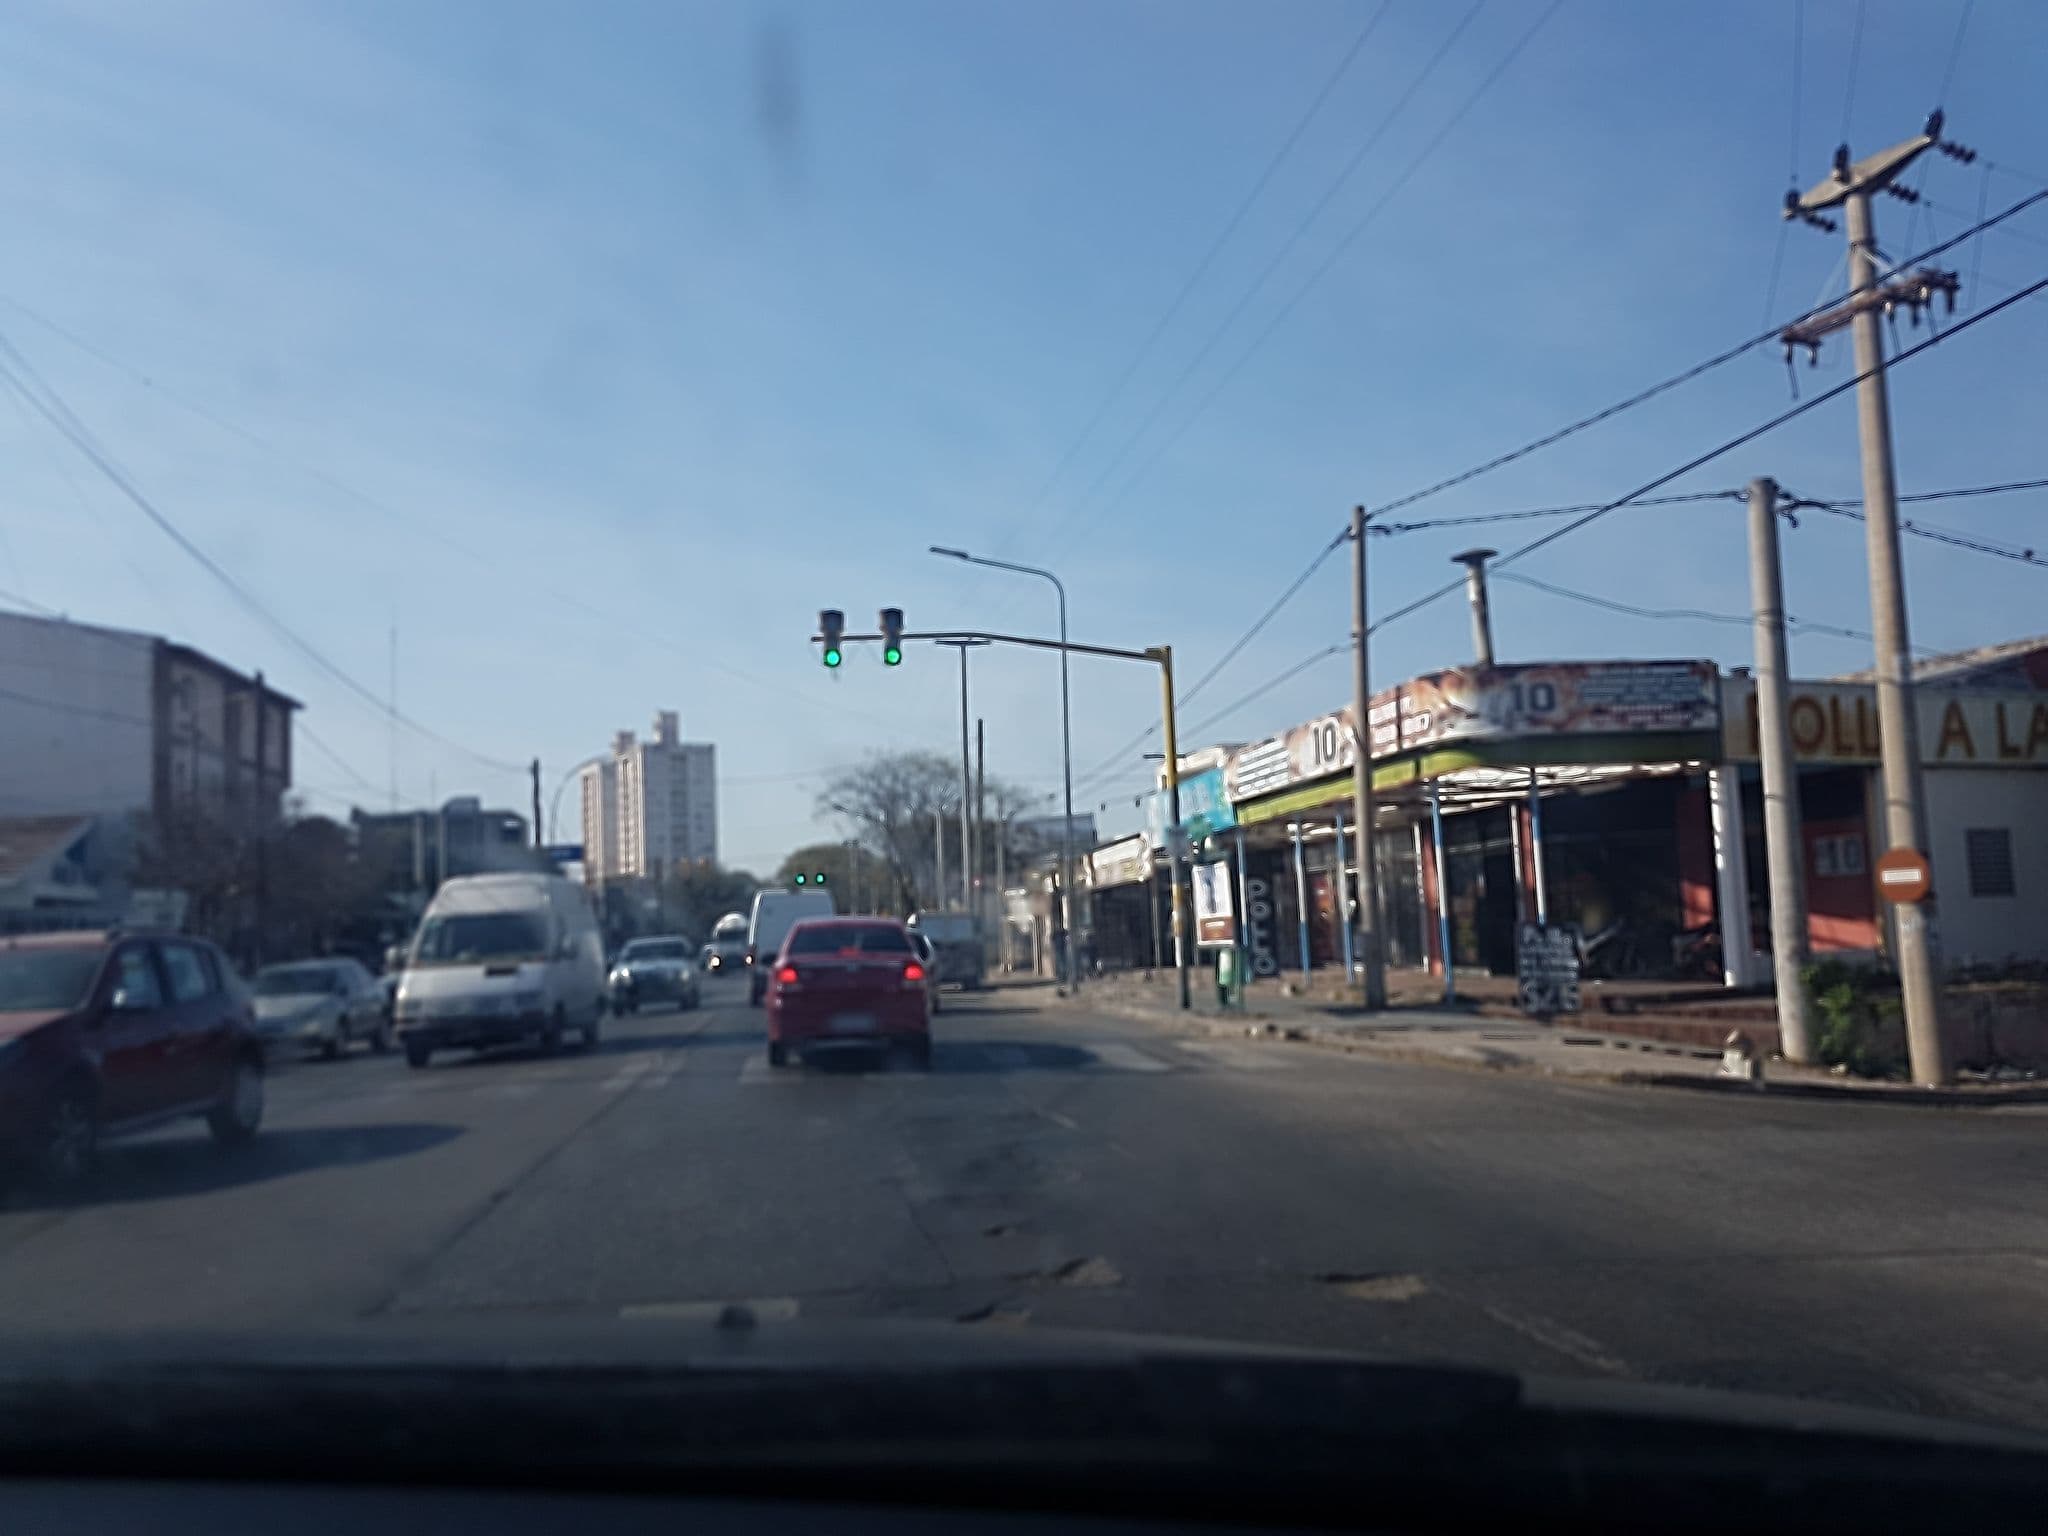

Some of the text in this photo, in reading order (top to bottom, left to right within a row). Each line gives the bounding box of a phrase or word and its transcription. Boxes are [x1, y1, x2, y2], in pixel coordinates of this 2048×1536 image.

[1511, 681, 1556, 712] 10
[1313, 721, 1337, 767] 10
[1936, 702, 1977, 759] A
